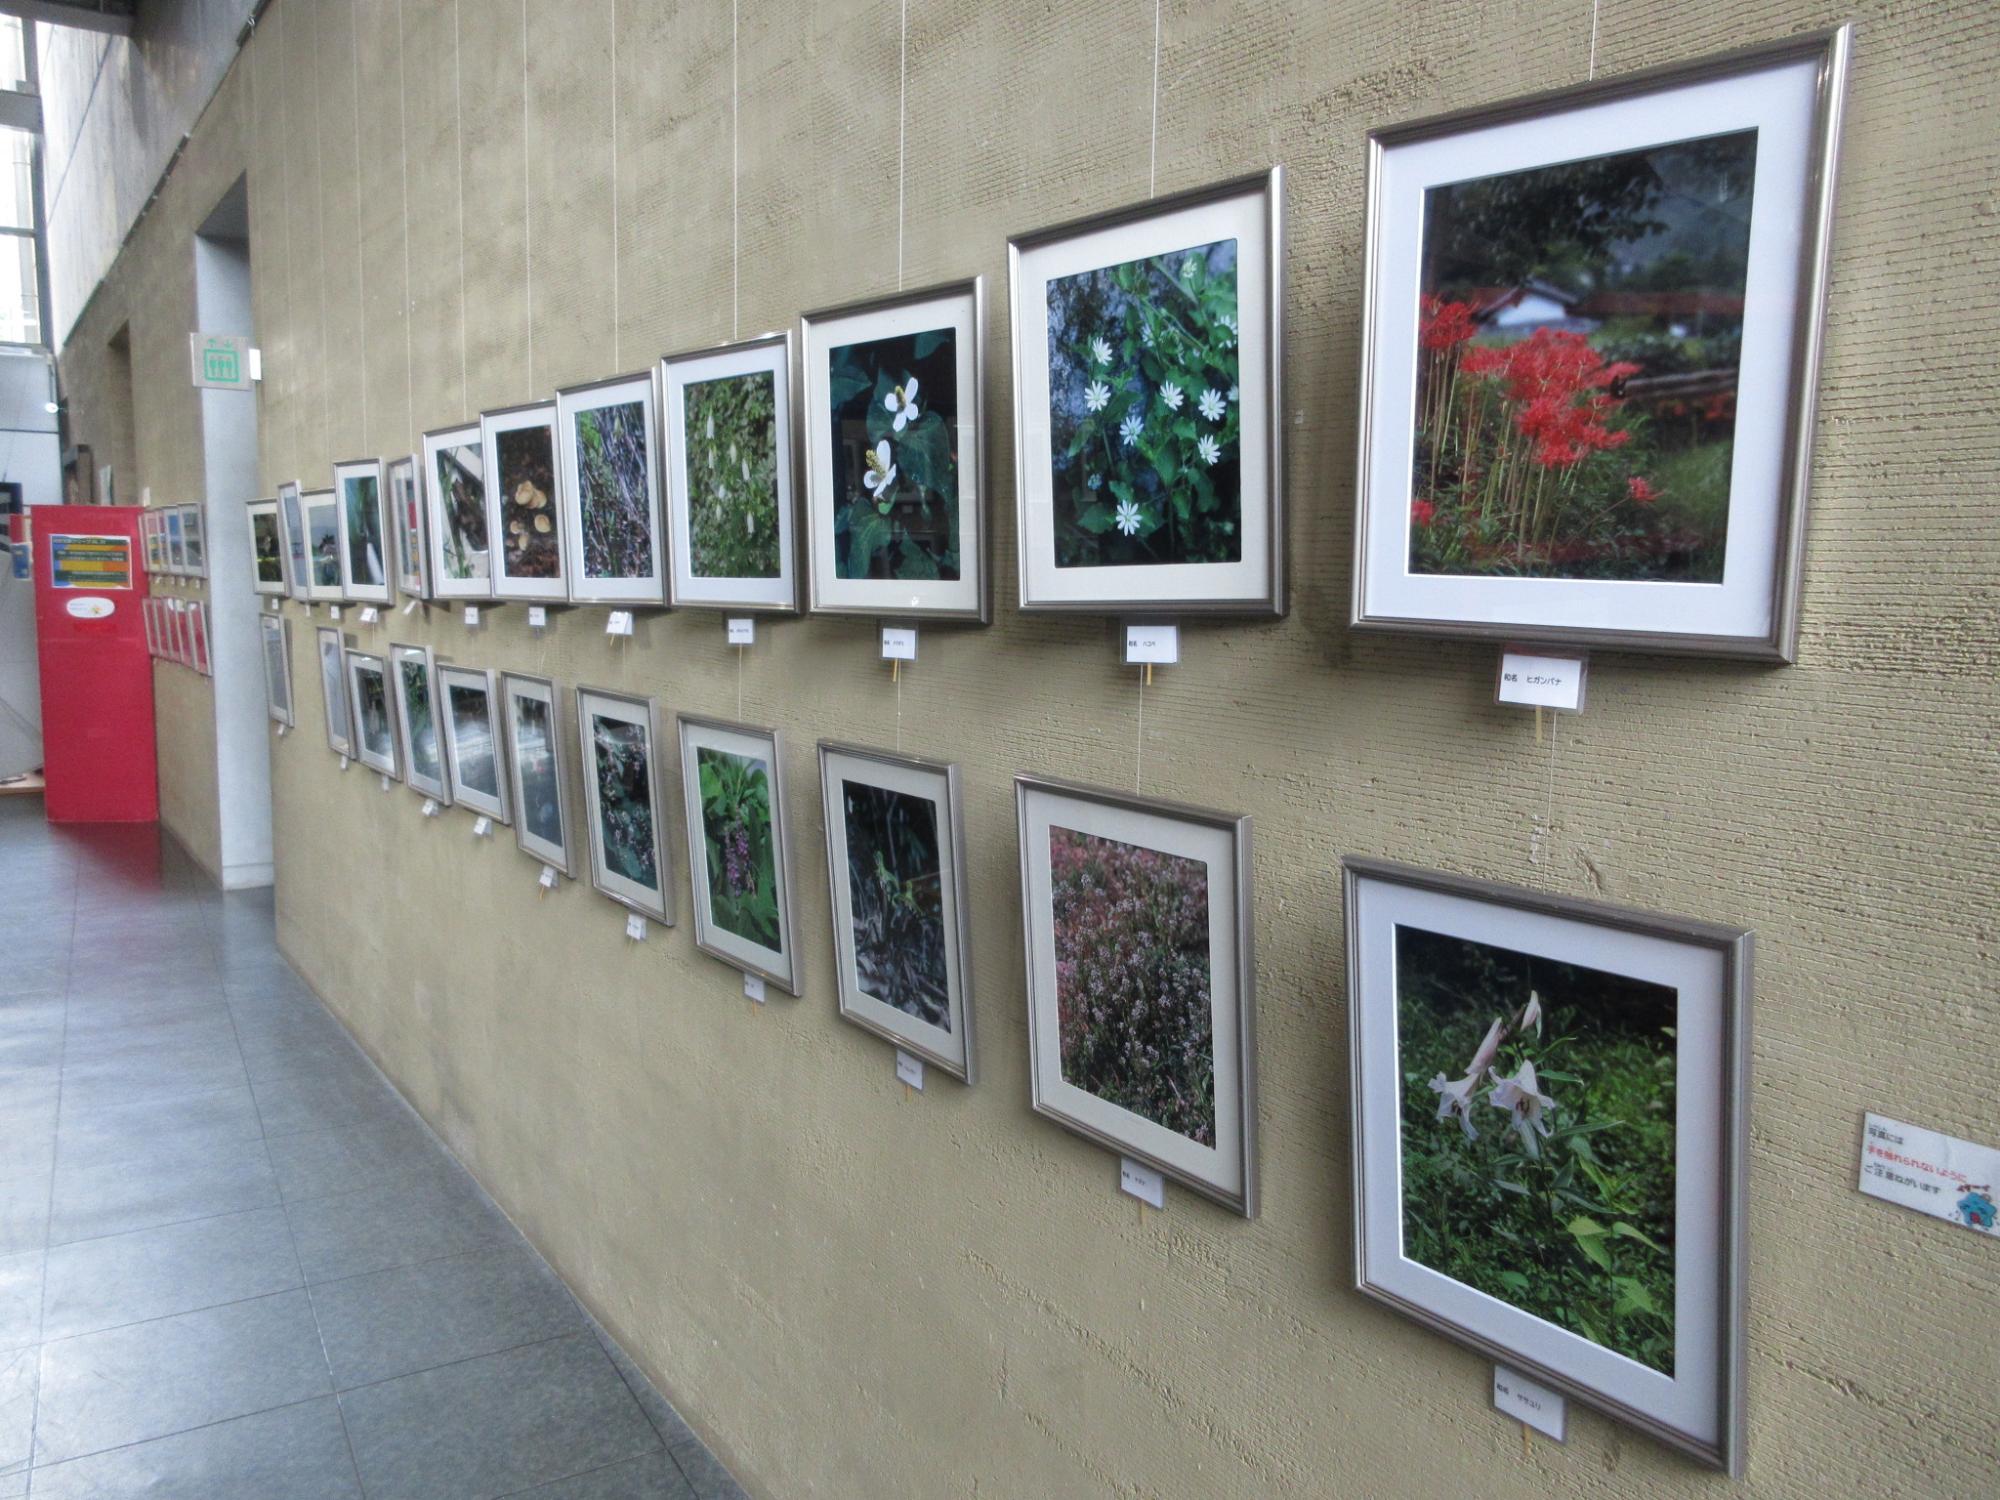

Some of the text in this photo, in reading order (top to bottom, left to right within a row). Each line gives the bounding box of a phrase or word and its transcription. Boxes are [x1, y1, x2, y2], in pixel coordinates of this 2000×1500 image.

[1503, 673, 1562, 686] 和名 ヒガンバナ
[1868, 1126, 1904, 1145] 写真には
